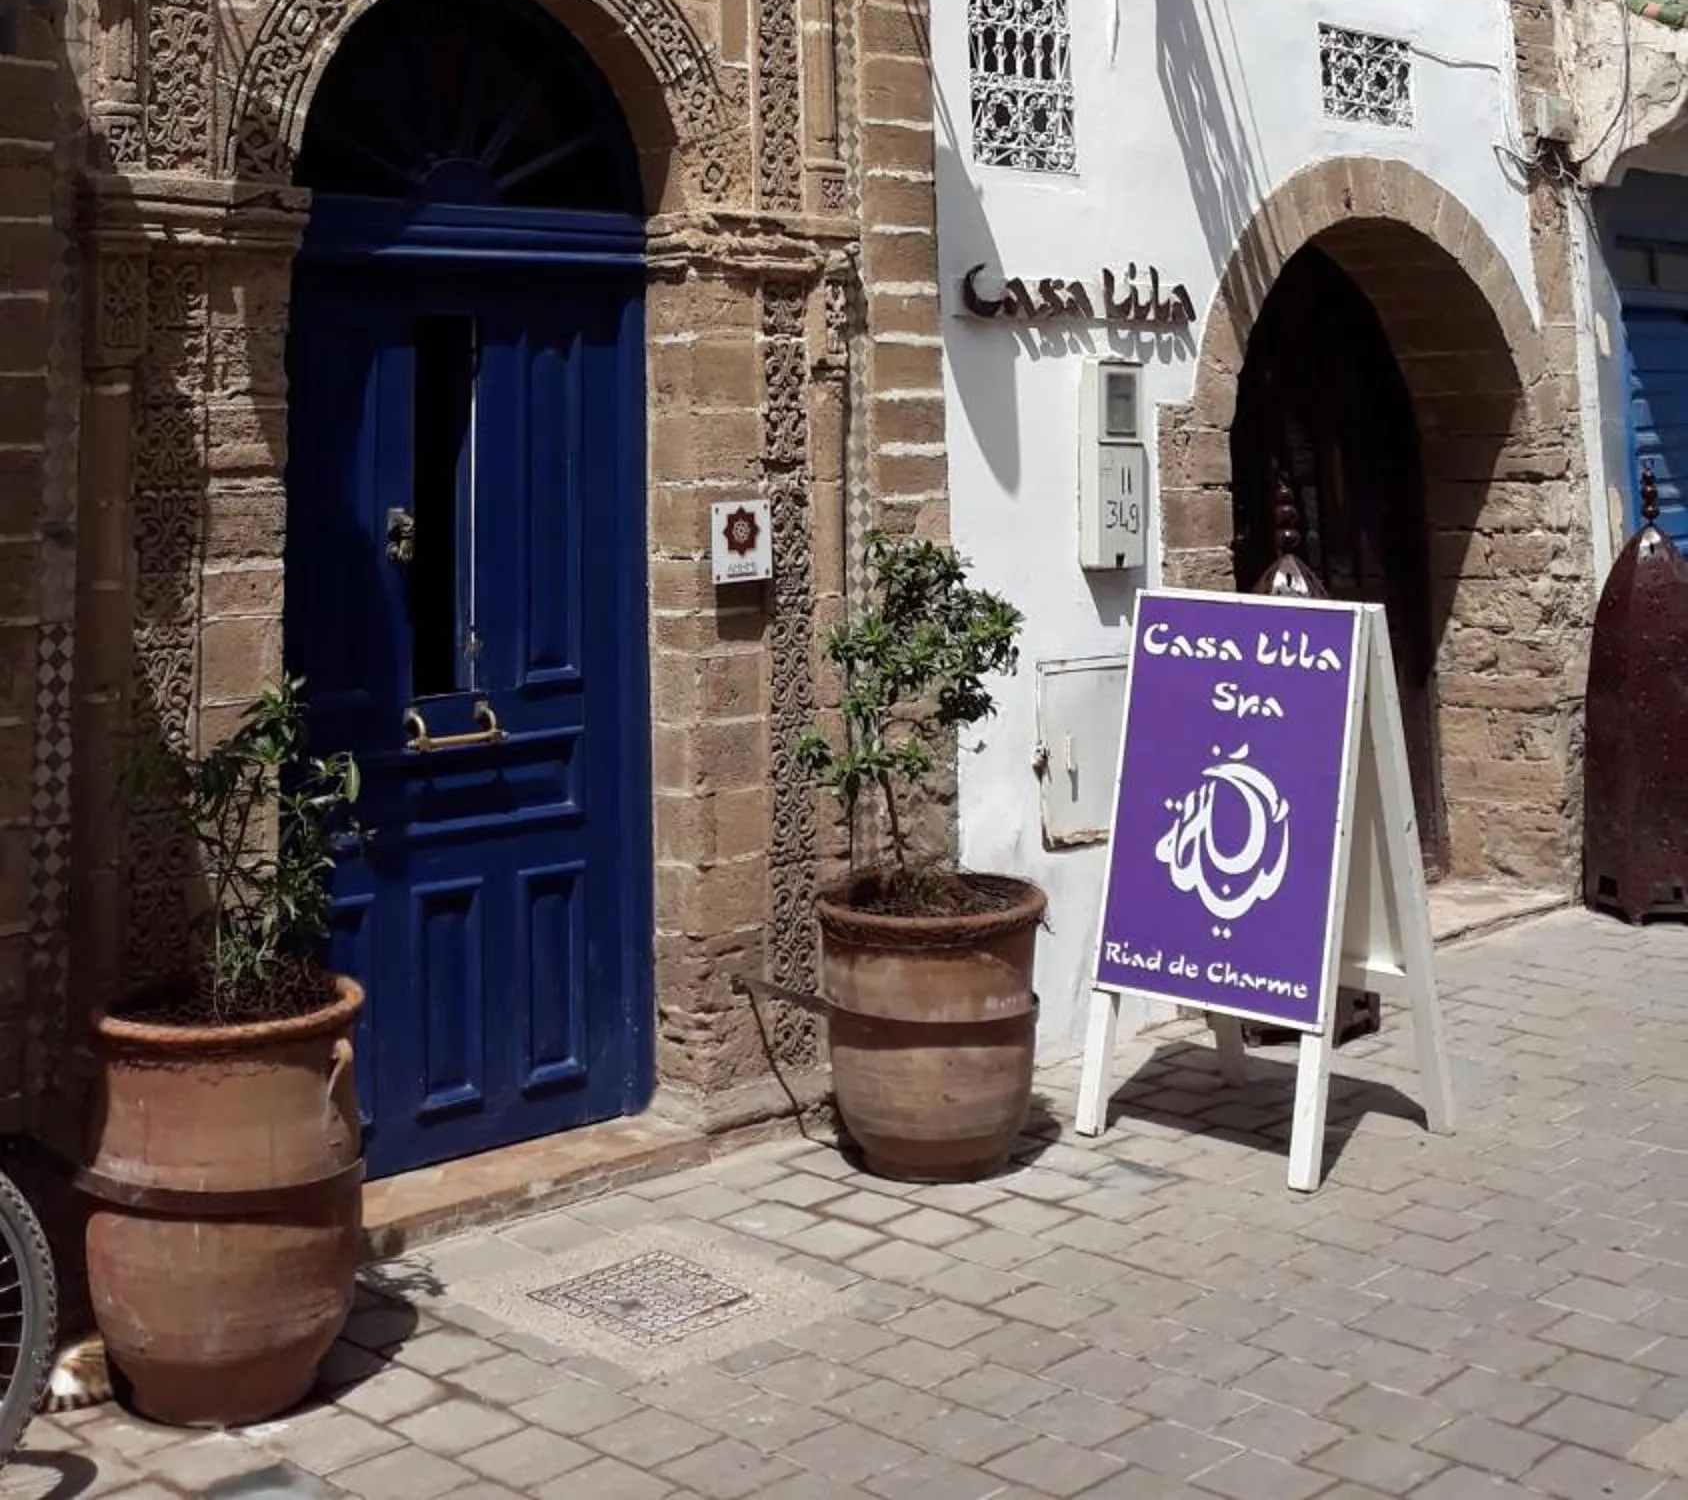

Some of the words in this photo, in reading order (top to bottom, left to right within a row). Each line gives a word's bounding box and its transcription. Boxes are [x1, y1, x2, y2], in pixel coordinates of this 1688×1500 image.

[963, 263, 1094, 318] Casa
[1102, 262, 1196, 321] Lila
[1143, 623, 1243, 661] Casa
[1256, 630, 1341, 671] Lila
[1211, 681, 1284, 718] Spa
[1105, 941, 1162, 972] Riad
[1168, 955, 1199, 978] de
[1207, 962, 1308, 999] Charme
